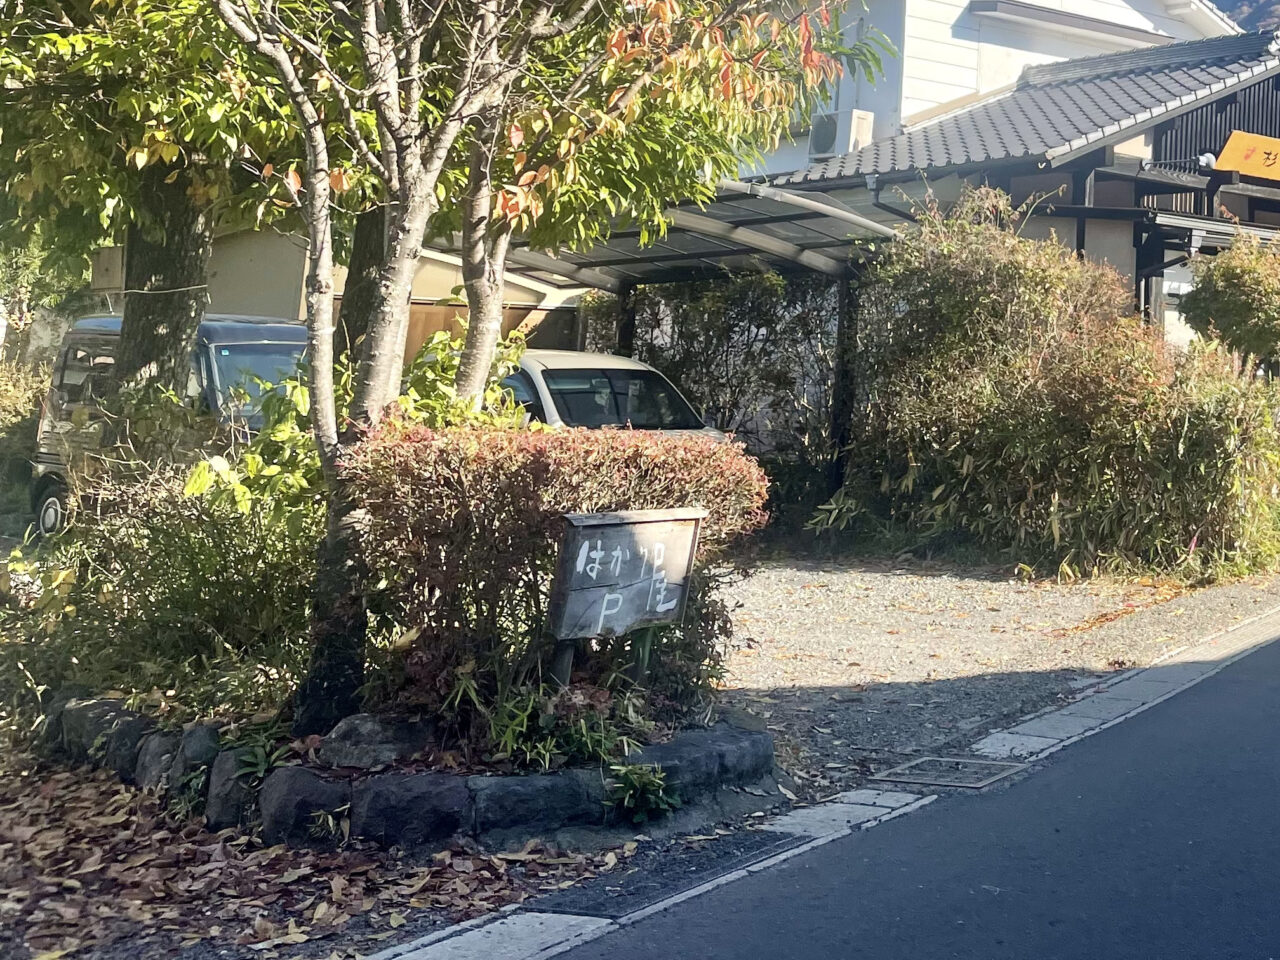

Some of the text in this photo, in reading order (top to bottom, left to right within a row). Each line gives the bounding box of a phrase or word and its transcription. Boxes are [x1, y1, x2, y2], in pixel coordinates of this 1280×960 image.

[576, 540, 677, 613] はかり屋
[596, 592, 624, 633] P
